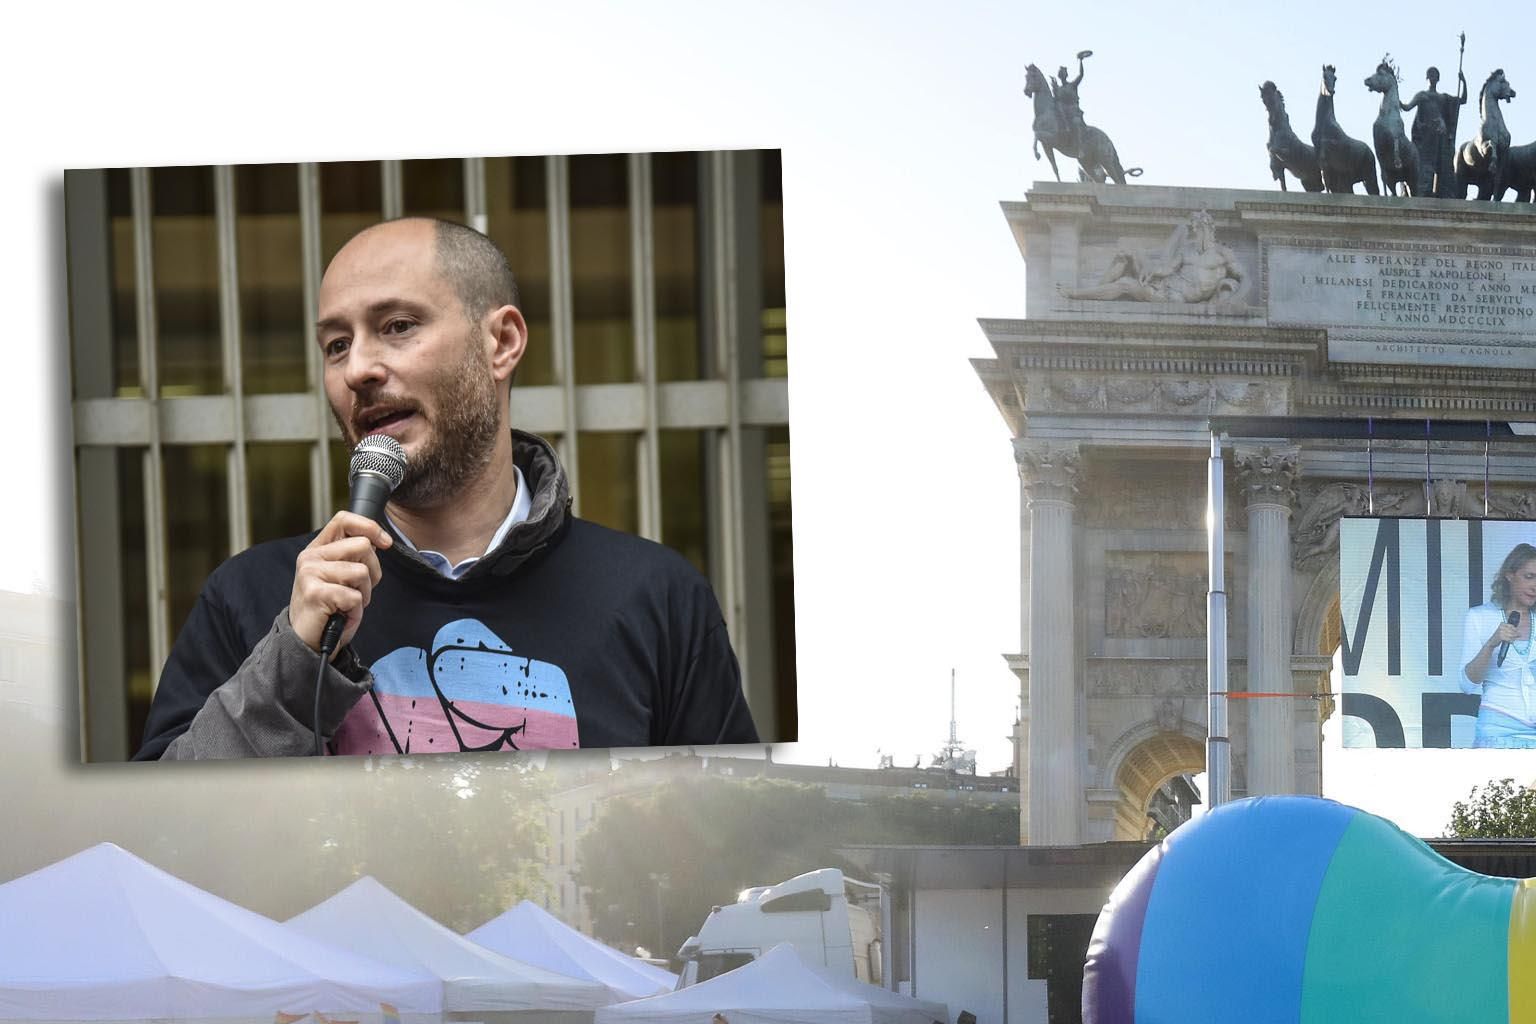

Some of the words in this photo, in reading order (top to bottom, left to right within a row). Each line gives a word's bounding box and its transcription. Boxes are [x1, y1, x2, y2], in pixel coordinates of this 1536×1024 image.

[1326, 254, 1356, 265] ALLE
[1364, 255, 1427, 266] SPERANZE
[1436, 258, 1457, 268] DEL
[1466, 260, 1503, 270] REGNO
[1378, 268, 1421, 278] AUSPICE
[1430, 270, 1494, 281] NAPOLEONE
[1315, 276, 1373, 287] MILANESI
[1382, 279, 1459, 290] DEDICARONO
[1366, 290, 1372, 299] E
[1382, 290, 1440, 301] FRANCATI
[1451, 293, 1466, 302] DA
[1357, 301, 1437, 312] FELICEMENTE
[1446, 304, 1535, 318] RESTITUIRONO
[1438, 315, 1506, 327] MDCCCLIX
